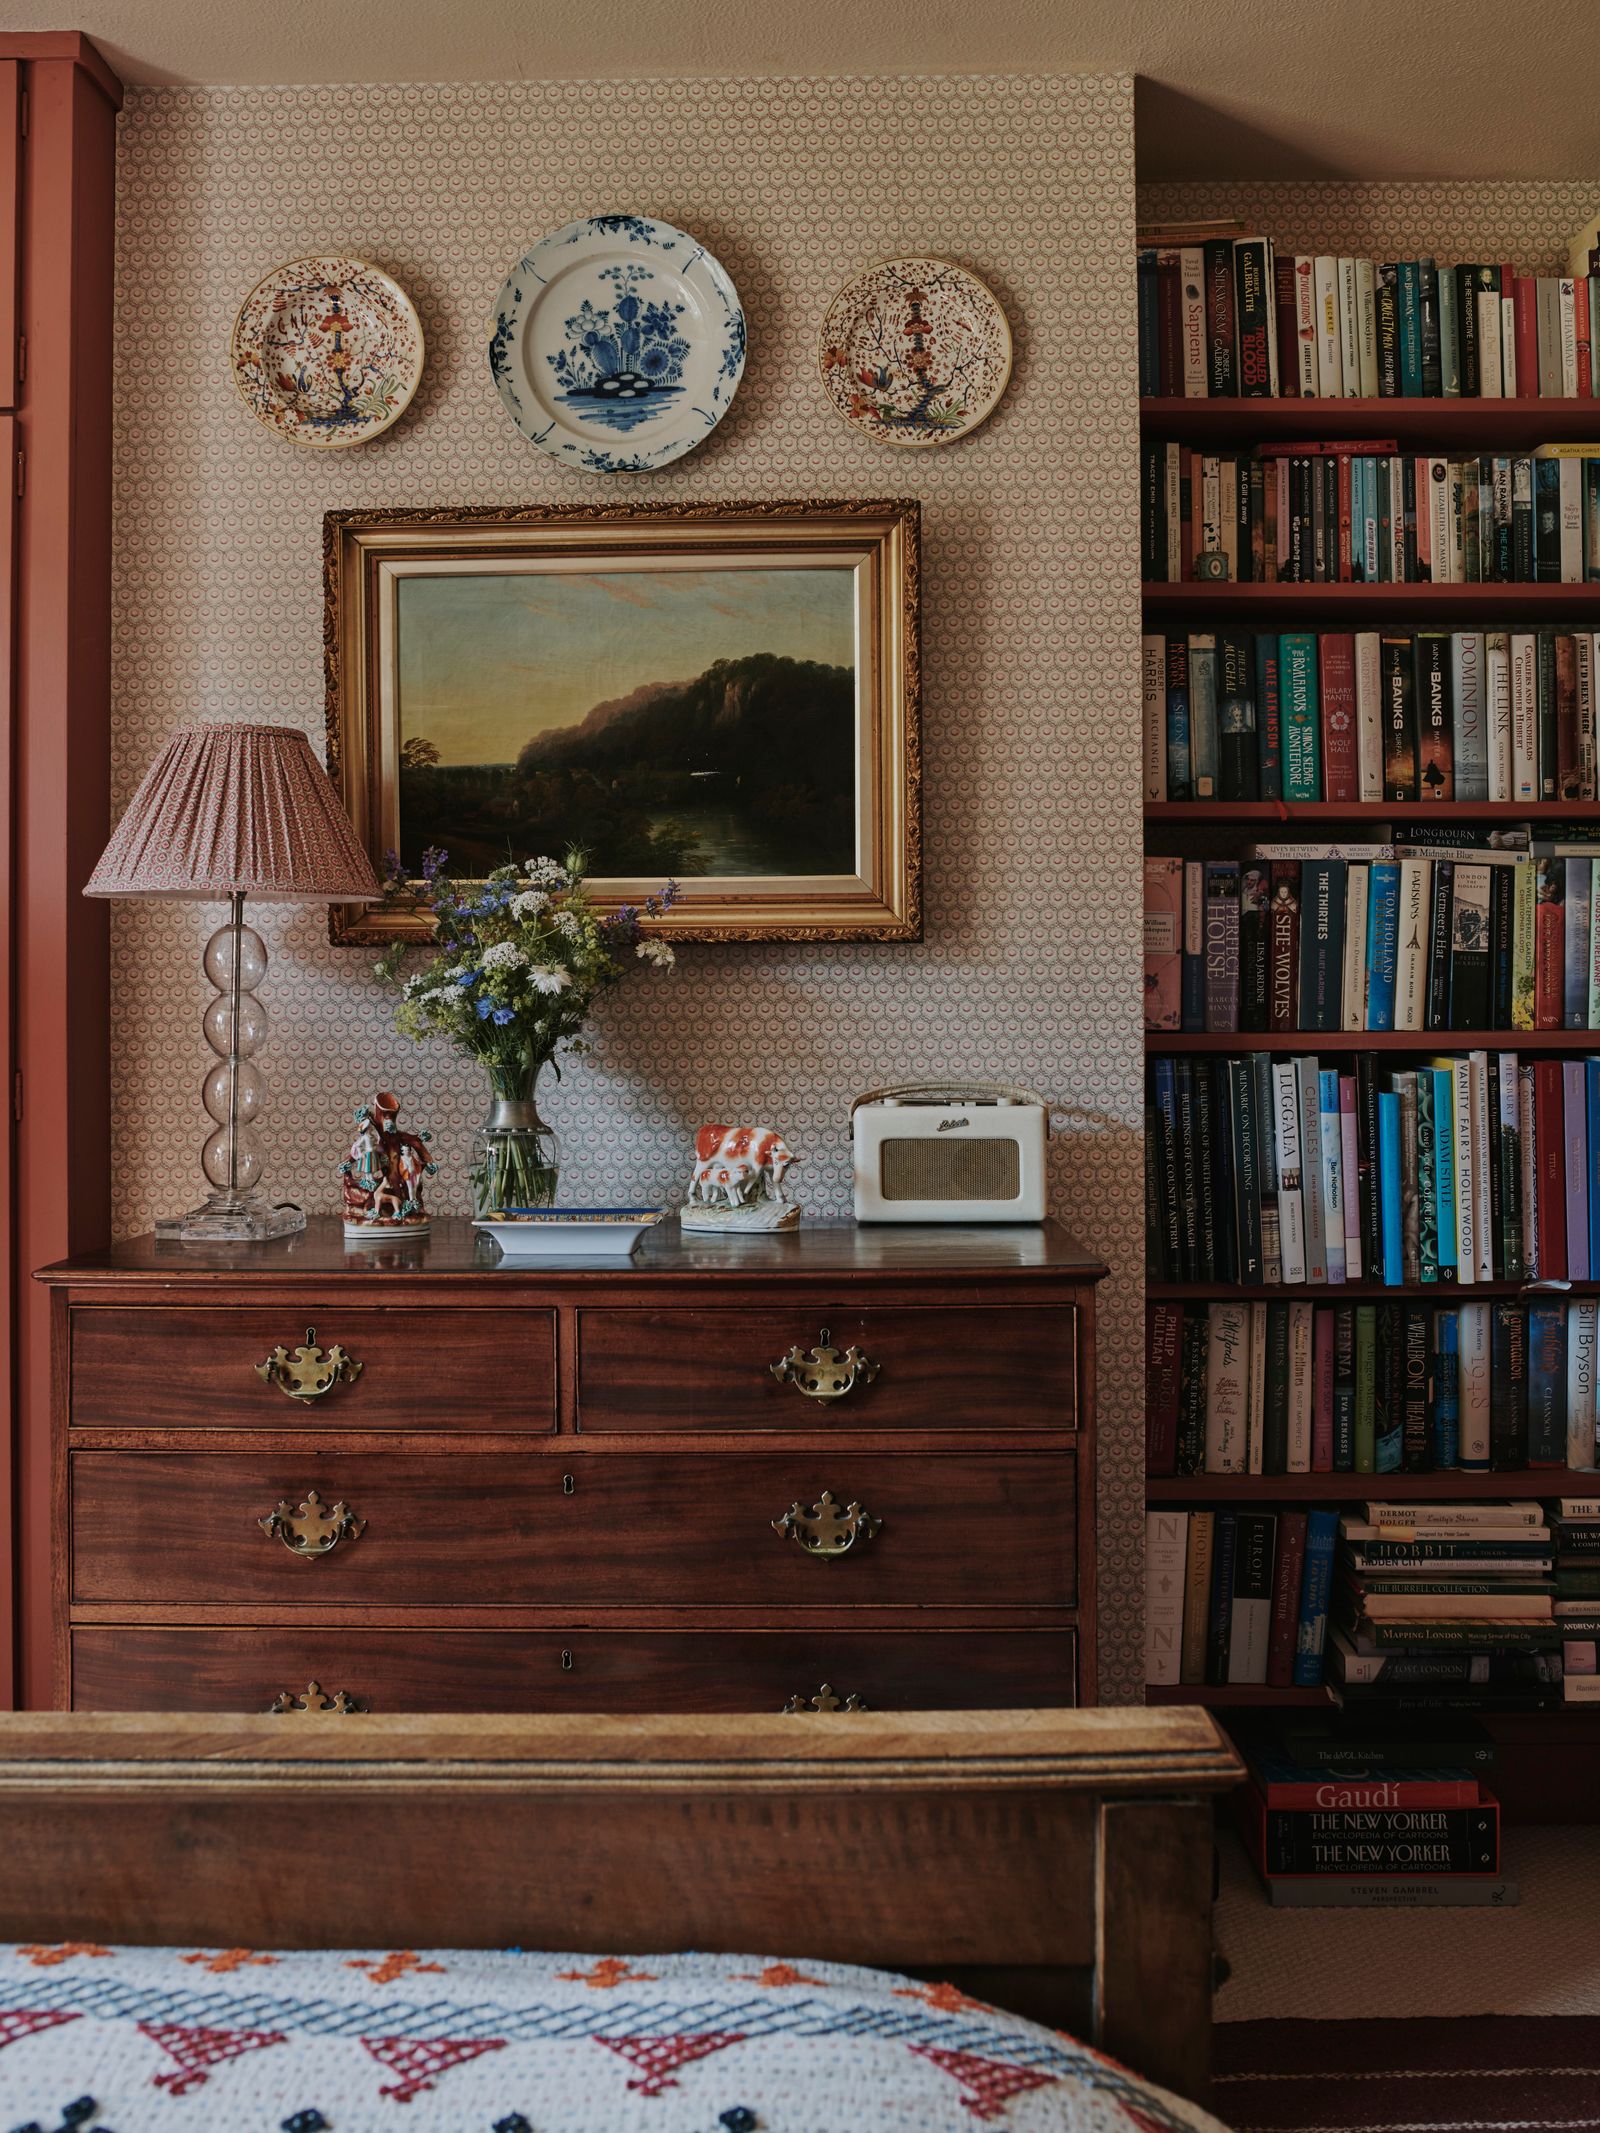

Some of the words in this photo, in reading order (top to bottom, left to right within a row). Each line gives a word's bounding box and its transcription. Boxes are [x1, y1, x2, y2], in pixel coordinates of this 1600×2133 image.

[1215, 249, 1225, 264] THE
[1244, 252, 1255, 312] GALBRAITH
[1382, 285, 1391, 298] THE
[1215, 267, 1229, 334] SILKWORM
[1301, 276, 1311, 324] CIVILISATIONS
[1381, 298, 1396, 333] CRUELTY
[1185, 304, 1203, 365] Sapiens
[1383, 334, 1394, 349] MEN
[1214, 338, 1223, 389] GALBRAITH
[1222, 348, 1230, 378] ROBERT
[1242, 335, 1257, 386] BLOOD
[1255, 326, 1267, 384] TROUBLED
[1384, 351, 1394, 369] EMER
[1385, 369, 1395, 396] MARTIN
[1241, 471, 1248, 481] AA
[1239, 506, 1247, 525] away
[1499, 488, 1507, 521] RANKIN
[1500, 528, 1508, 544] THE
[1500, 546, 1508, 571] FALLS
[1145, 649, 1156, 701] HARRIS
[1224, 640, 1237, 693] MUGHAL
[1238, 650, 1246, 668] THE
[1265, 659, 1278, 687] KATE
[1525, 645, 1533, 686] CAVALIERS
[1238, 669, 1247, 687] LAST
[1461, 637, 1479, 739] DOMINION
[1496, 663, 1508, 692] THE
[1515, 657, 1523, 711] CHRISTOPHER
[1392, 676, 1403, 730] BANKS
[1525, 688, 1533, 704] AND
[1265, 692, 1279, 749] ATKINSON
[1496, 698, 1509, 734] LINK
[1515, 714, 1524, 749] HIBBERT
[1525, 706, 1534, 761] ROUNDHEADS
[1289, 725, 1302, 786] MONTEFIORE
[1302, 726, 1313, 753] SIMON
[1303, 756, 1314, 785] SEBAG
[1462, 742, 1470, 784] SANSOM
[1410, 826, 1475, 840] LONGBOURN
[1419, 848, 1454, 860] Midnight
[1456, 851, 1474, 859] Blue
[1318, 871, 1329, 892] THE
[1501, 872, 1509, 913] ANDREW
[1317, 893, 1329, 940] THIRTIES
[1385, 890, 1395, 918] TOM
[1437, 885, 1449, 936] Vermeer's
[1207, 904, 1226, 980] HOUSE
[1226, 904, 1239, 980] PERFECT
[1500, 914, 1508, 949] TAYLOR
[1257, 942, 1265, 963] LISA
[1275, 915, 1290, 1018] SHE-WOLVES
[1383, 922, 1395, 983] HOLLAND
[1436, 940, 1447, 959] Hat
[1257, 963, 1265, 1004] JARDINE
[1317, 972, 1325, 1005] GARDINER
[1367, 1082, 1375, 1119] ENGLISH
[1459, 1064, 1469, 1110] VANITY
[1521, 1089, 1529, 1106] ON
[1163, 1091, 1172, 1140] BUILDINGS
[1181, 1093, 1190, 1145] BUILDINGS
[1199, 1081, 1209, 1132] BUILDINGS
[1279, 1073, 1295, 1158] LUGGALA
[1522, 1109, 1530, 1130] THE
[1165, 1144, 1173, 1157] OF
[1183, 1147, 1191, 1159] OF
[1201, 1136, 1210, 1147] OF
[1368, 1121, 1376, 1160] COUNTRY
[1440, 1127, 1451, 1163] ADAM
[1460, 1118, 1470, 1160] FAIR'S
[1522, 1132, 1530, 1167] FRINGE
[1166, 1161, 1176, 1206] COUNTY
[1185, 1162, 1194, 1204] COUNTY
[1202, 1150, 1211, 1184] NORTH
[1369, 1162, 1377, 1190] HOUSE
[1548, 1152, 1556, 1180] TITIAN
[1204, 1186, 1213, 1227] COUNTY
[1331, 1176, 1339, 1209] Nicholson
[1441, 1171, 1452, 1208] STYLE
[1170, 1209, 1179, 1249] ANTRIM
[1187, 1206, 1196, 1247] ARMAGH
[1370, 1191, 1378, 1237] INTERIORS
[1461, 1169, 1472, 1256] HOLLYWOOD
[1206, 1229, 1215, 1260] DOWN
[1410, 1313, 1424, 1321] THE
[1579, 1304, 1594, 1329] Bill
[1152, 1305, 1166, 1365] PULLMAN
[1164, 1316, 1177, 1357] PHILIP
[1275, 1311, 1286, 1366] EMPIRES
[1338, 1310, 1352, 1377] VIENNA
[1498, 1310, 1526, 1381] Lamentation
[1406, 1322, 1427, 1390] WHALEBONE
[1576, 1334, 1595, 1394] Bryson
[1274, 1384, 1285, 1408] SEA
[1341, 1396, 1349, 1412] EVA
[1341, 1415, 1349, 1454] MENASSE
[1406, 1400, 1425, 1435] THEATRE
[1570, 1506, 1594, 1514] THE
[1194, 1520, 1206, 1587] PHOENIX
[1379, 1544, 1457, 1558] HOBBIT
[1570, 1532, 1587, 1540] THE
[1250, 1523, 1264, 1590] EUROPE
[1280, 1551, 1291, 1590] ALISON
[1278, 1593, 1289, 1620] WEIR
[1373, 1585, 1389, 1593] THE
[1391, 1585, 1430, 1593] BURRELL
[1431, 1585, 1489, 1593] COLLECTION
[1383, 1629, 1424, 1639] MAPPING
[1425, 1629, 1463, 1639] LONDON
[1563, 1623, 1592, 1632] ANDREW
[1316, 1782, 1401, 1808] Gaudí
[1310, 1813, 1341, 1831] THE
[1344, 1813, 1381, 1831] NEW
[1383, 1813, 1449, 1831] YORKER
[1312, 1832, 1381, 1840] ENCYCLOPEDIA
[1383, 1832, 1397, 1840] OF
[1398, 1832, 1449, 1840] CARTOONS
[1312, 1844, 1342, 1863] THE
[1344, 1844, 1383, 1863] NEW
[1386, 1844, 1450, 1863] YORKER
[1315, 1863, 1384, 1872] ENCYCLOPEDIA
[1386, 1863, 1399, 1872] OF
[1400, 1863, 1452, 1872] CARTOONS
[1350, 1886, 1389, 1894] STEVEN
[1392, 1886, 1440, 1894] GAMBREL
